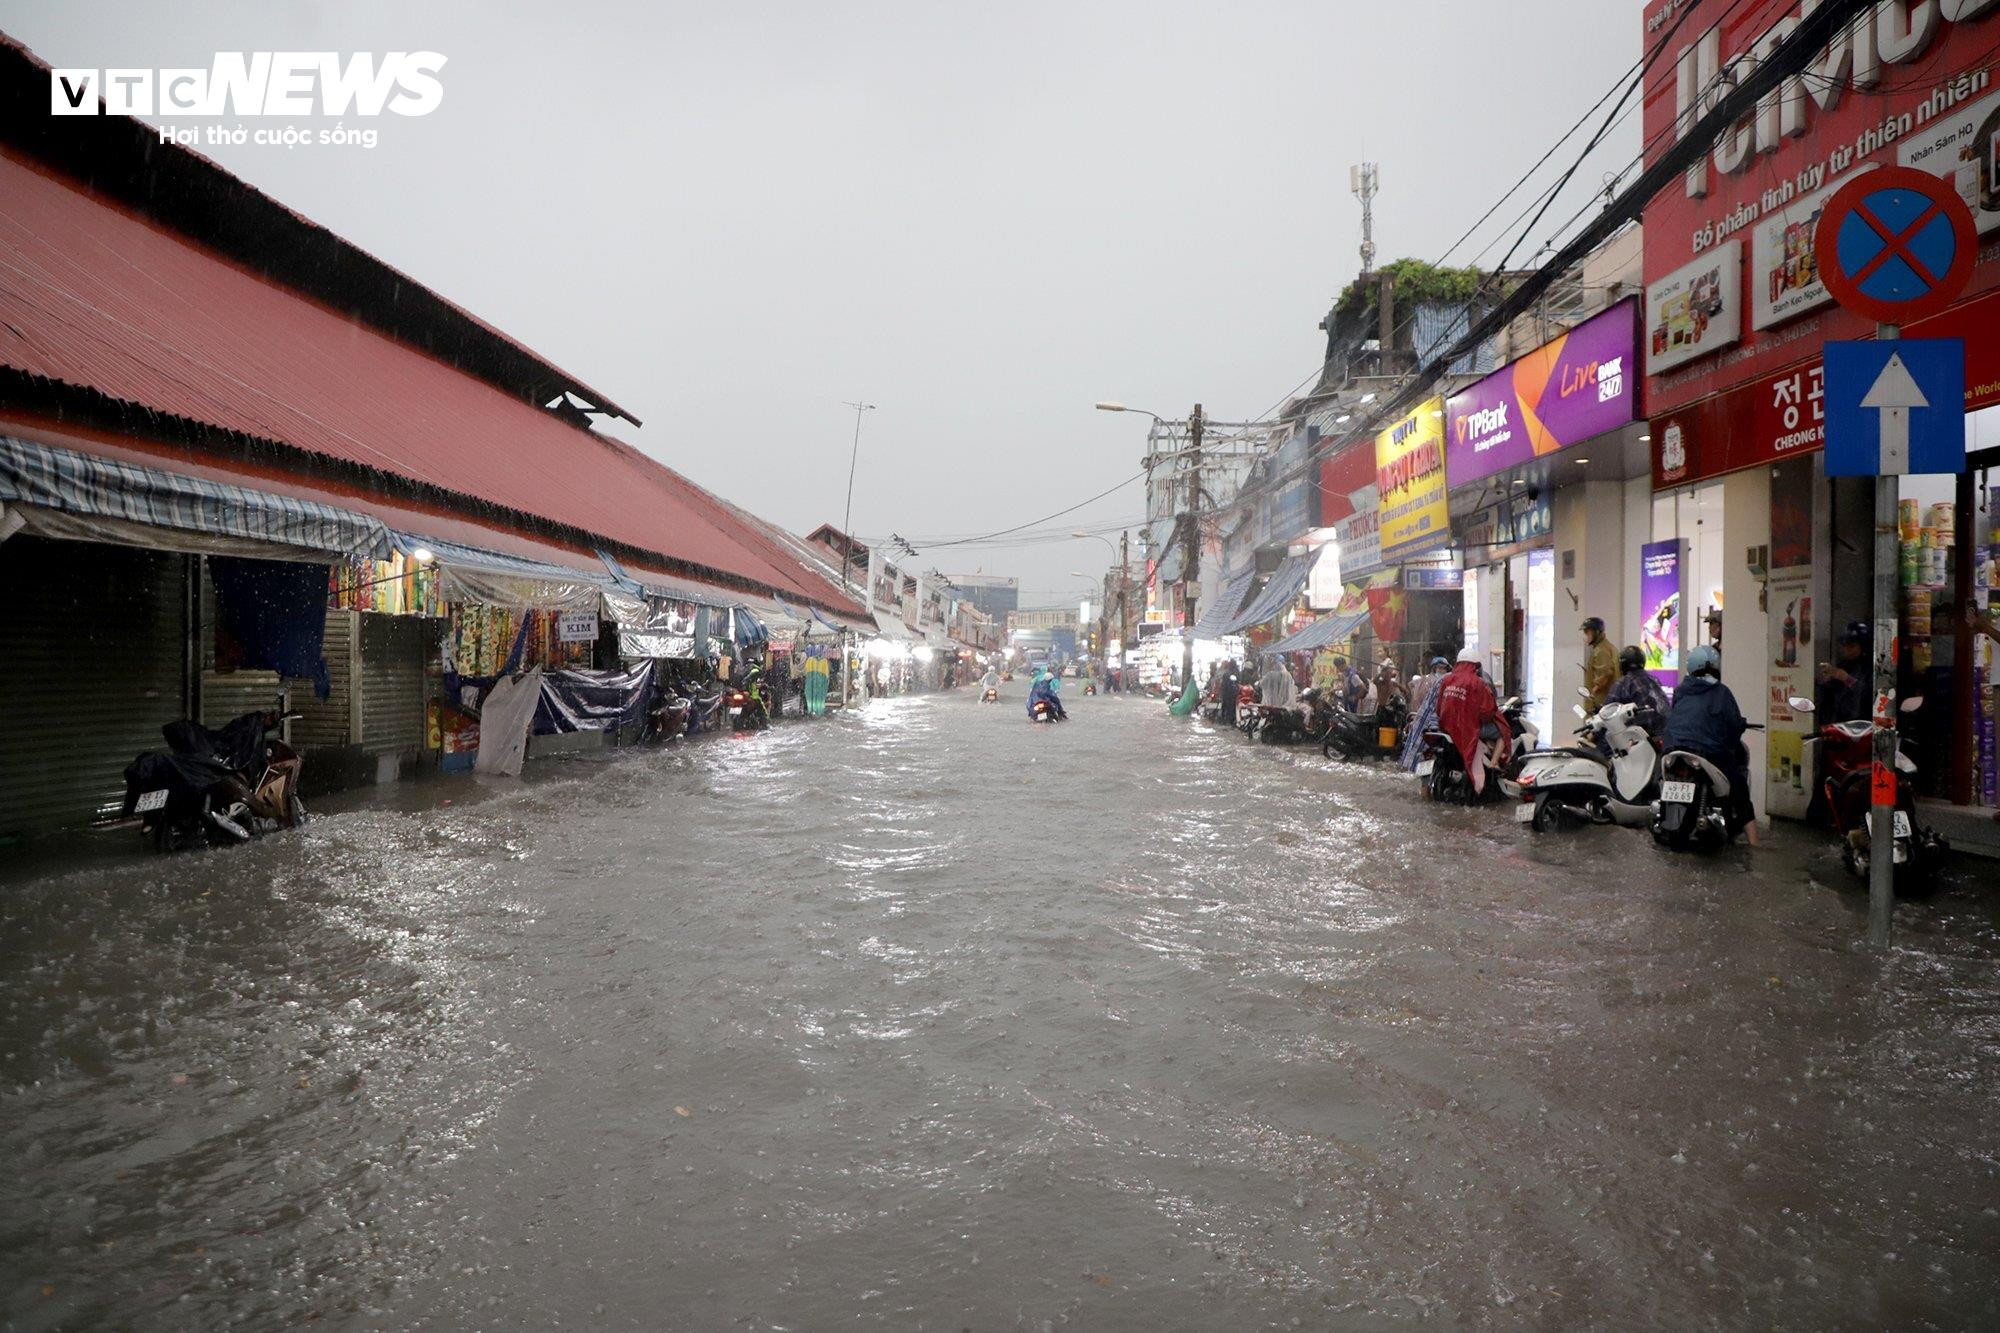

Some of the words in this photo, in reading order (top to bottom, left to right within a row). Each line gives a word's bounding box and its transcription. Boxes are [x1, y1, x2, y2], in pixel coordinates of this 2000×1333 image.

[1692, 217, 1715, 254] Bổ
[1716, 203, 1759, 247] phẩm
[1829, 143, 1853, 176] từ
[1856, 111, 1913, 159] thiên
[1916, 68, 1991, 125] nhiên
[1910, 144, 1934, 165] Nhân
[1935, 132, 1957, 151] Sâm
[1467, 401, 1508, 440] TPBank
[1774, 429, 1815, 451] CHEONG
[567, 624, 591, 632] KIM
